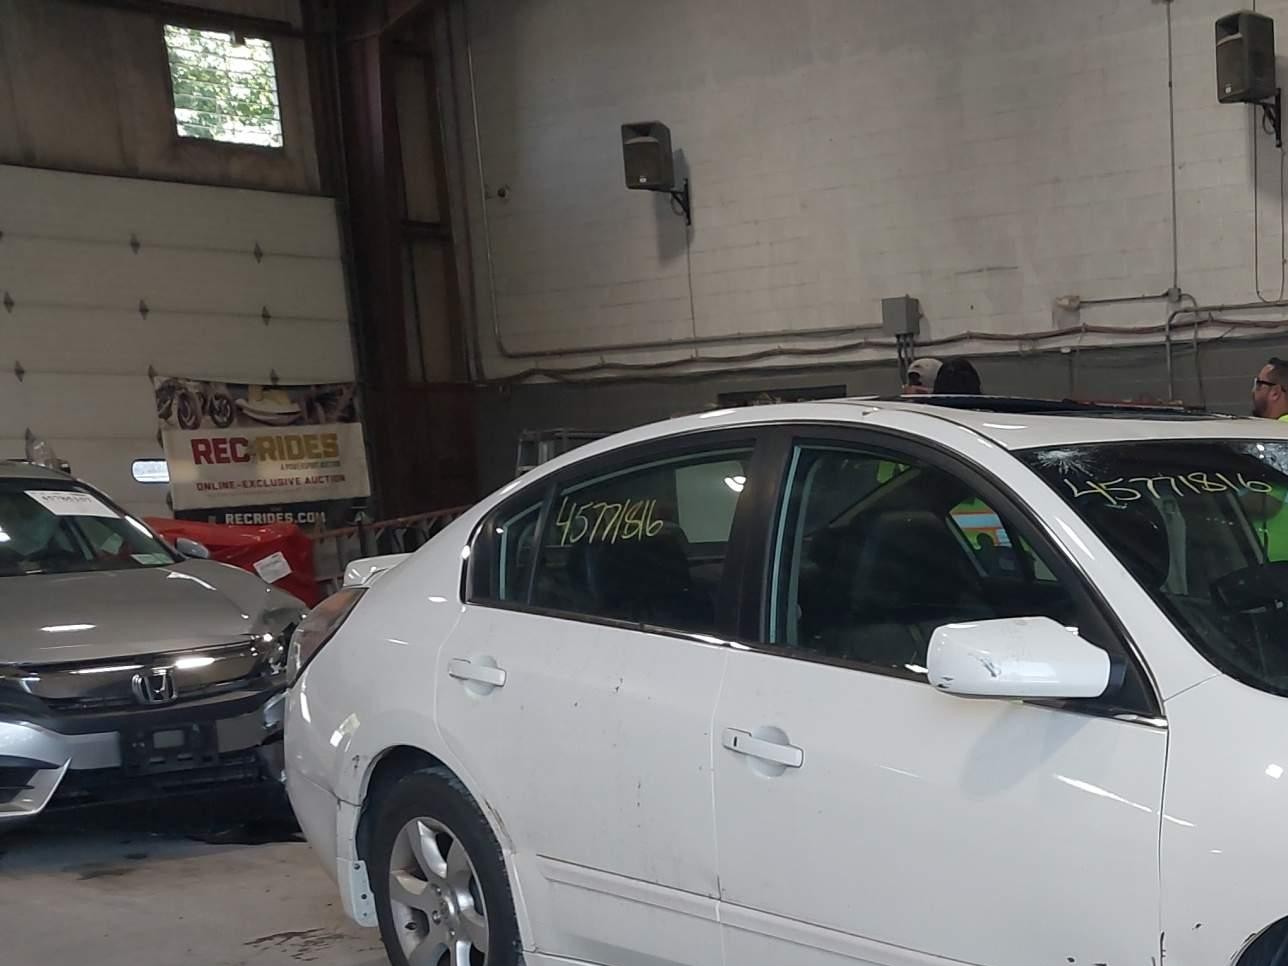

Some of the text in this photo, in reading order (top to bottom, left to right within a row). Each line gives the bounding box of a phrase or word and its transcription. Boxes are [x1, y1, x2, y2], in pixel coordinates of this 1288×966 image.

[190, 433, 337, 465] REC RIDES
[196, 474, 346, 492] ONLINE-EXCLUSIVE AUCTION
[1063, 472, 1272, 506] 45771816
[556, 496, 663, 547] 45771816
